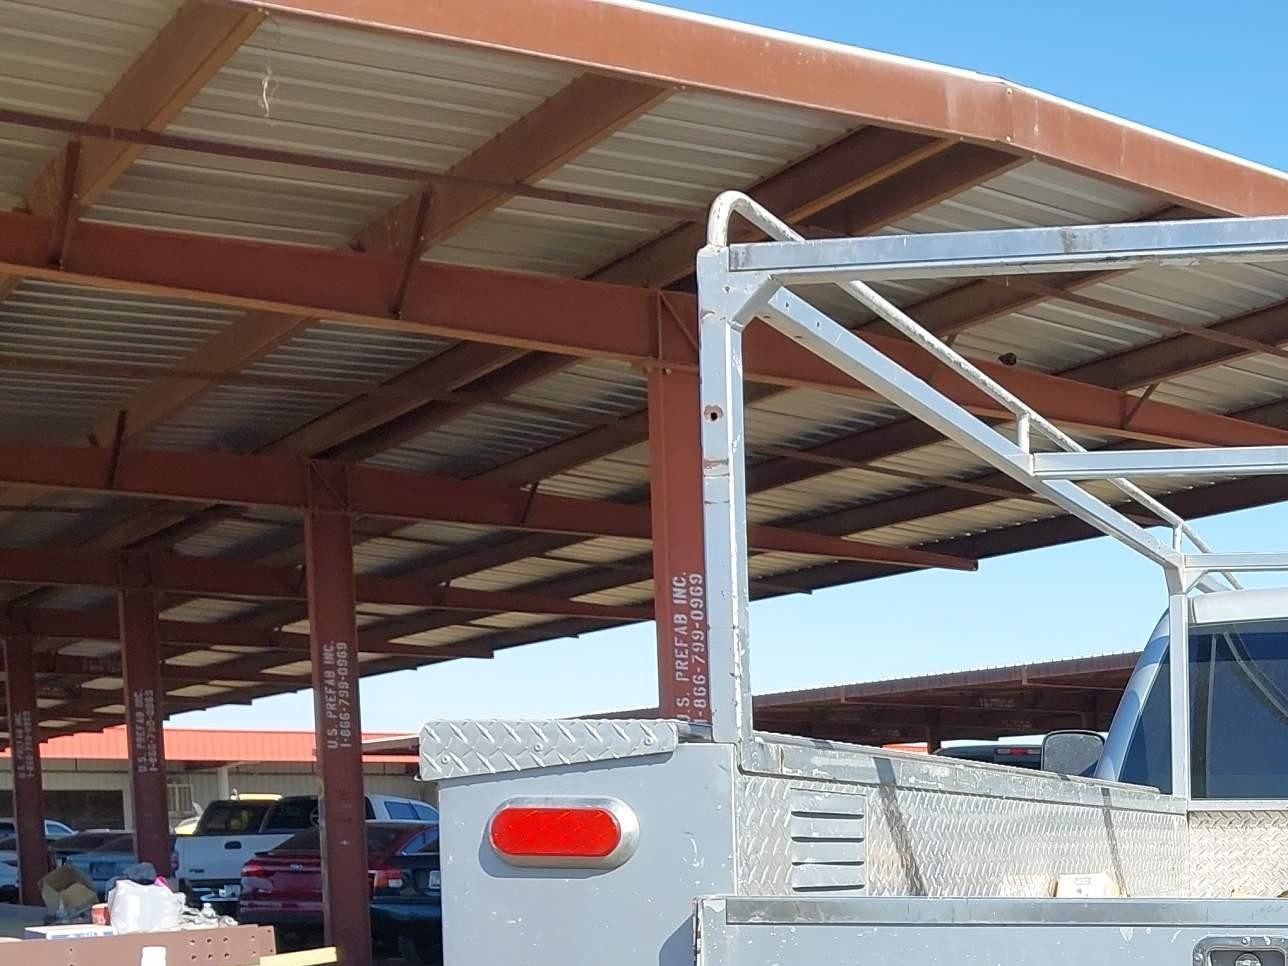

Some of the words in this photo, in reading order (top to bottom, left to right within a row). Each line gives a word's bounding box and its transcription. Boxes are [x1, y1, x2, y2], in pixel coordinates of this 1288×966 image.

[672, 572, 687, 604] INC.
[323, 641, 335, 664] INC.
[674, 613, 689, 681] PREFAB
[689, 573, 709, 724] 1-866-799-0969
[324, 670, 337, 718] PREFAB
[336, 642, 352, 748] 1-866-799-0969
[327, 726, 338, 749] U.S.
